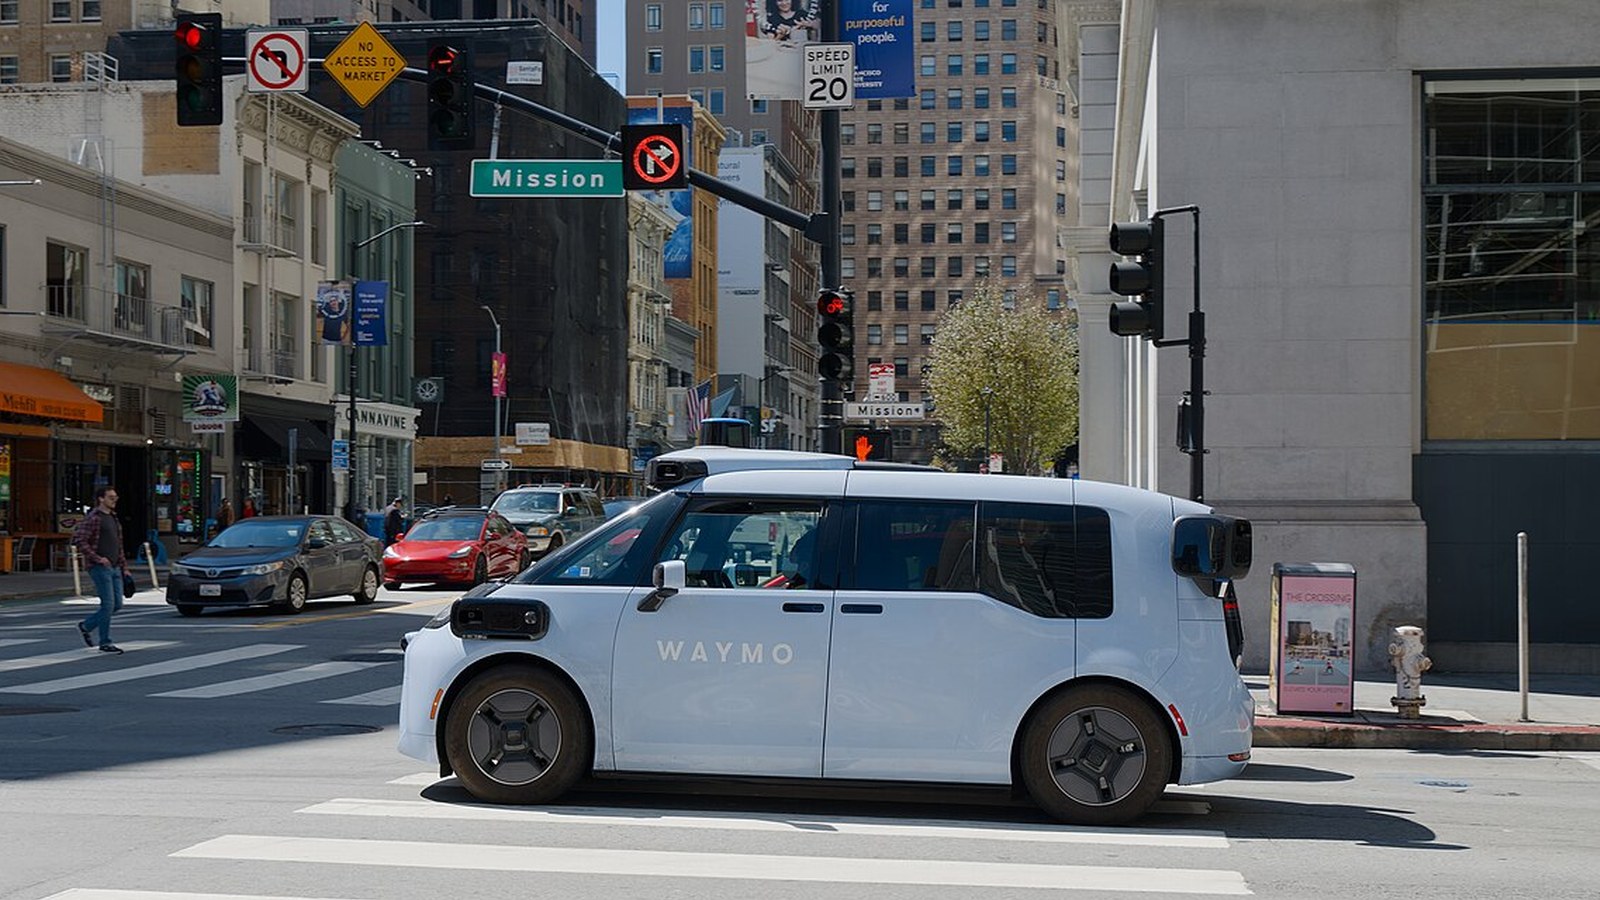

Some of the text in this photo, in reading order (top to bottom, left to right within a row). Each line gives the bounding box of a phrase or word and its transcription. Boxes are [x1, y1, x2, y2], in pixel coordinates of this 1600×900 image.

[872, 1, 889, 13] for
[845, 16, 905, 31] purposeful
[858, 31, 897, 45] people.
[358, 42, 374, 52] NO
[335, 56, 396, 67] ACCESS TO
[807, 50, 850, 62] SPEED
[811, 64, 845, 75] LIMIT
[344, 71, 387, 81] MARKET
[808, 77, 848, 102] 20
[492, 169, 605, 188] Mission
[3, 393, 37, 411] Mehfil
[858, 405, 913, 416] Mission
[760, 419, 777, 433] SF
[1286, 592, 1352, 603] THE CROSSING
[656, 639, 794, 665] WAYMO
